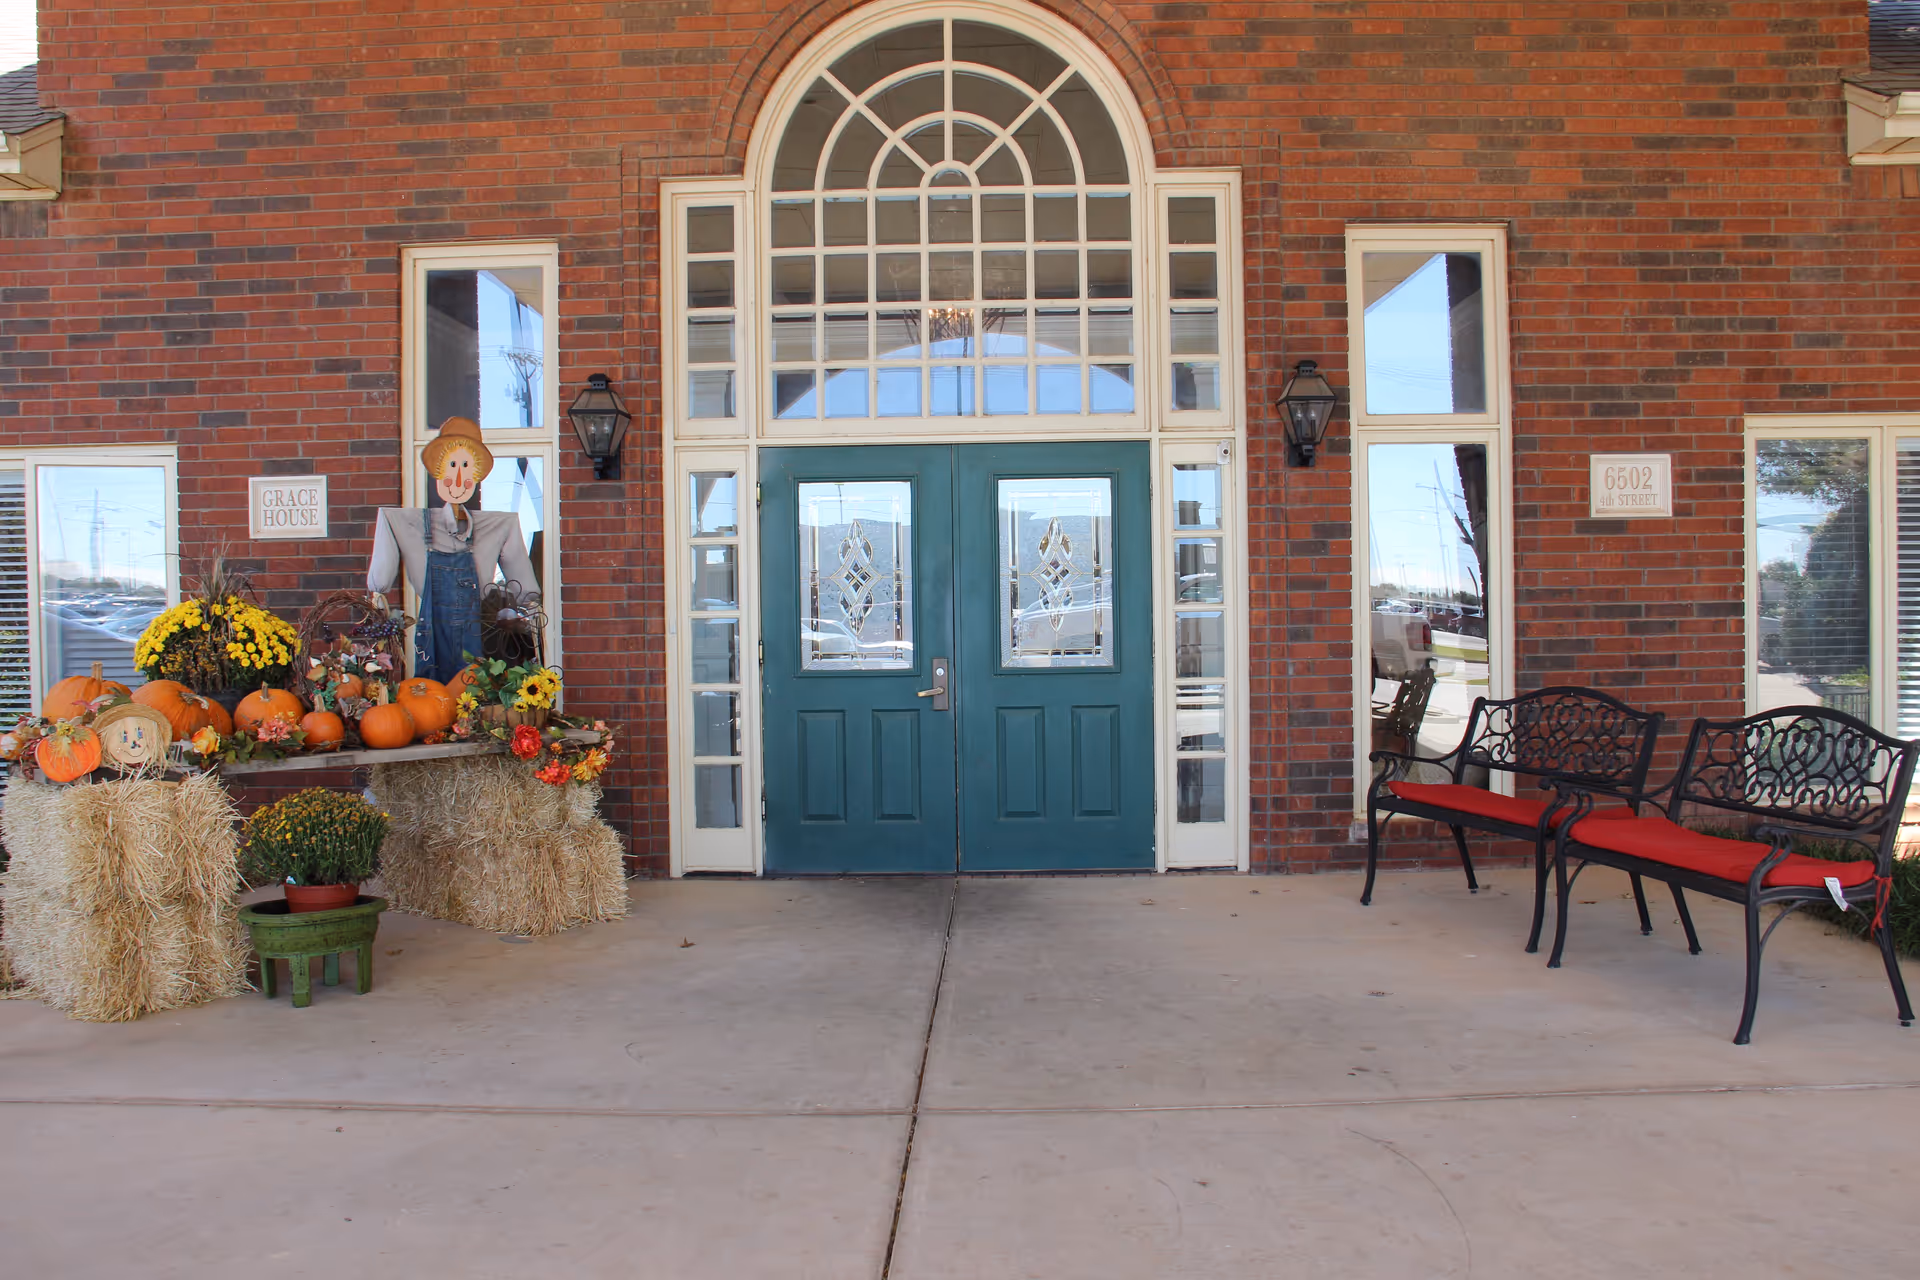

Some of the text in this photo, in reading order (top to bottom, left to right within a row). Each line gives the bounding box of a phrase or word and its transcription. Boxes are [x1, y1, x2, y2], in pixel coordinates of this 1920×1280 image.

[1604, 466, 1652, 490] 6502
[262, 489, 318, 507] GRACE
[1600, 492, 1658, 507] 4th STREET
[263, 508, 319, 527] HOUSE
